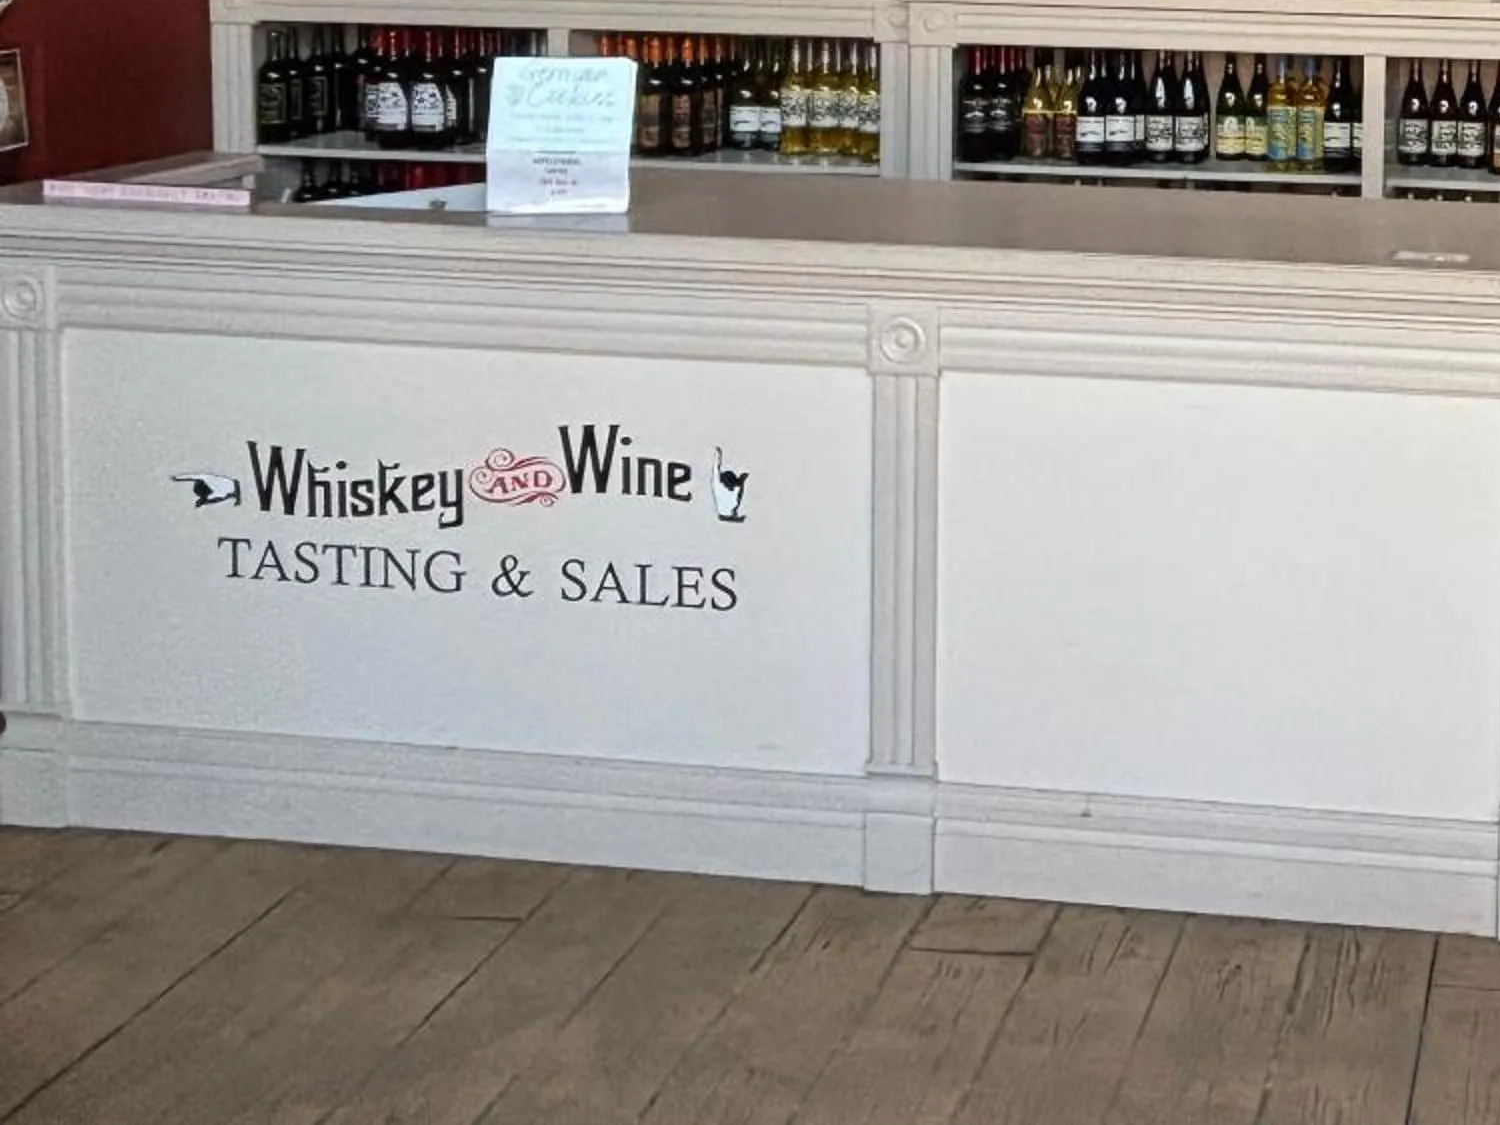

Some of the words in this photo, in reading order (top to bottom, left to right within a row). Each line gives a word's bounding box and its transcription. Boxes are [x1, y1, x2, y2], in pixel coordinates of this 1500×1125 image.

[246, 440, 464, 529] Whiskey
[487, 467, 552, 494] AND
[558, 424, 691, 501] Wine
[217, 537, 467, 593] TASTING
[491, 554, 533, 598] &
[560, 559, 738, 611] SALES
